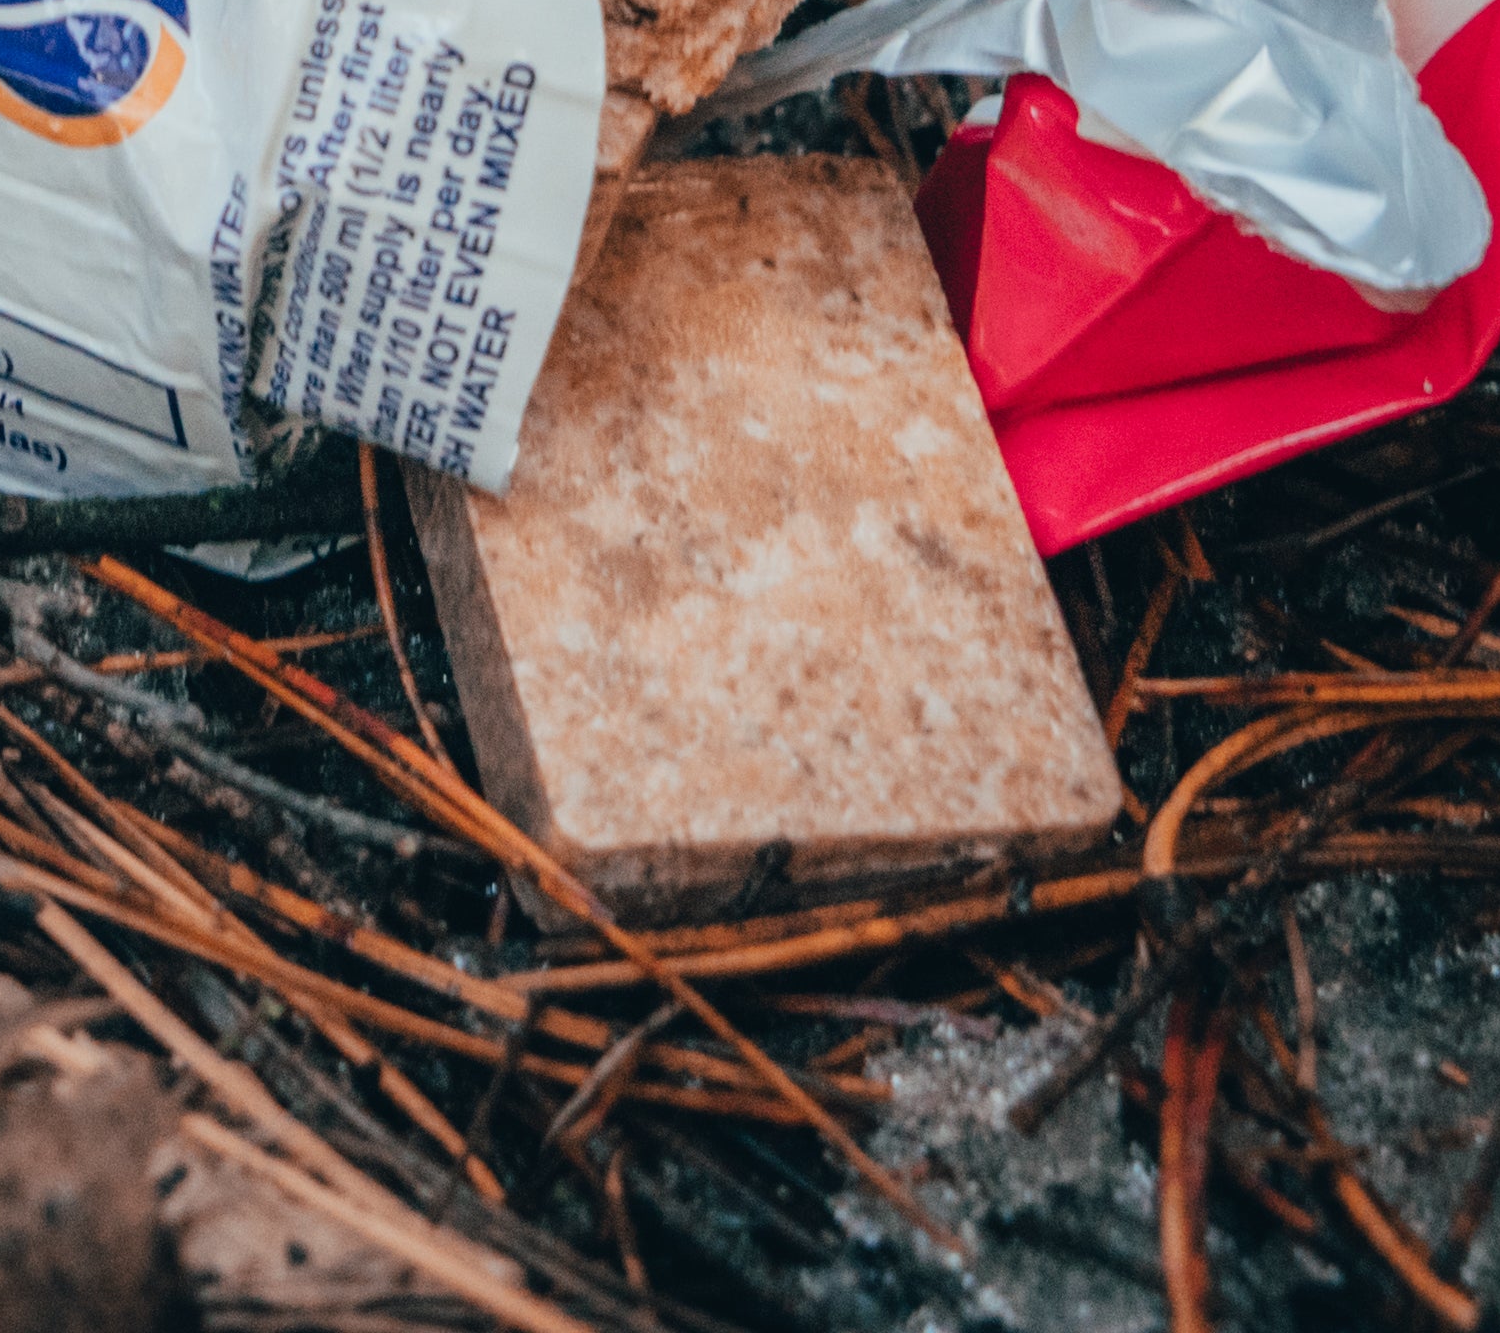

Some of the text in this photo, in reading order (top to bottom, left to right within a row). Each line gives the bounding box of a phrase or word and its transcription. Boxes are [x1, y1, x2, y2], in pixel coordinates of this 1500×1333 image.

[307, 90, 357, 191] After
[340, 0, 385, 82] first
[367, 32, 420, 117] liter
[406, 39, 466, 161] nearly
[449, 79, 494, 158] day.
[346, 125, 391, 199] (1/2
[384, 172, 422, 205] is
[337, 206, 369, 252] ml
[420, 314, 466, 390] NOT
[445, 200, 502, 308] EVEN
[477, 61, 537, 192] MIXED
[430, 167, 465, 234] per
[318, 250, 352, 307] 500
[359, 213, 416, 330] supply
[399, 239, 445, 312] liter
[308, 308, 342, 372] than
[333, 329, 377, 410] When
[382, 316, 422, 380] 1/10
[450, 307, 517, 431] WATER
